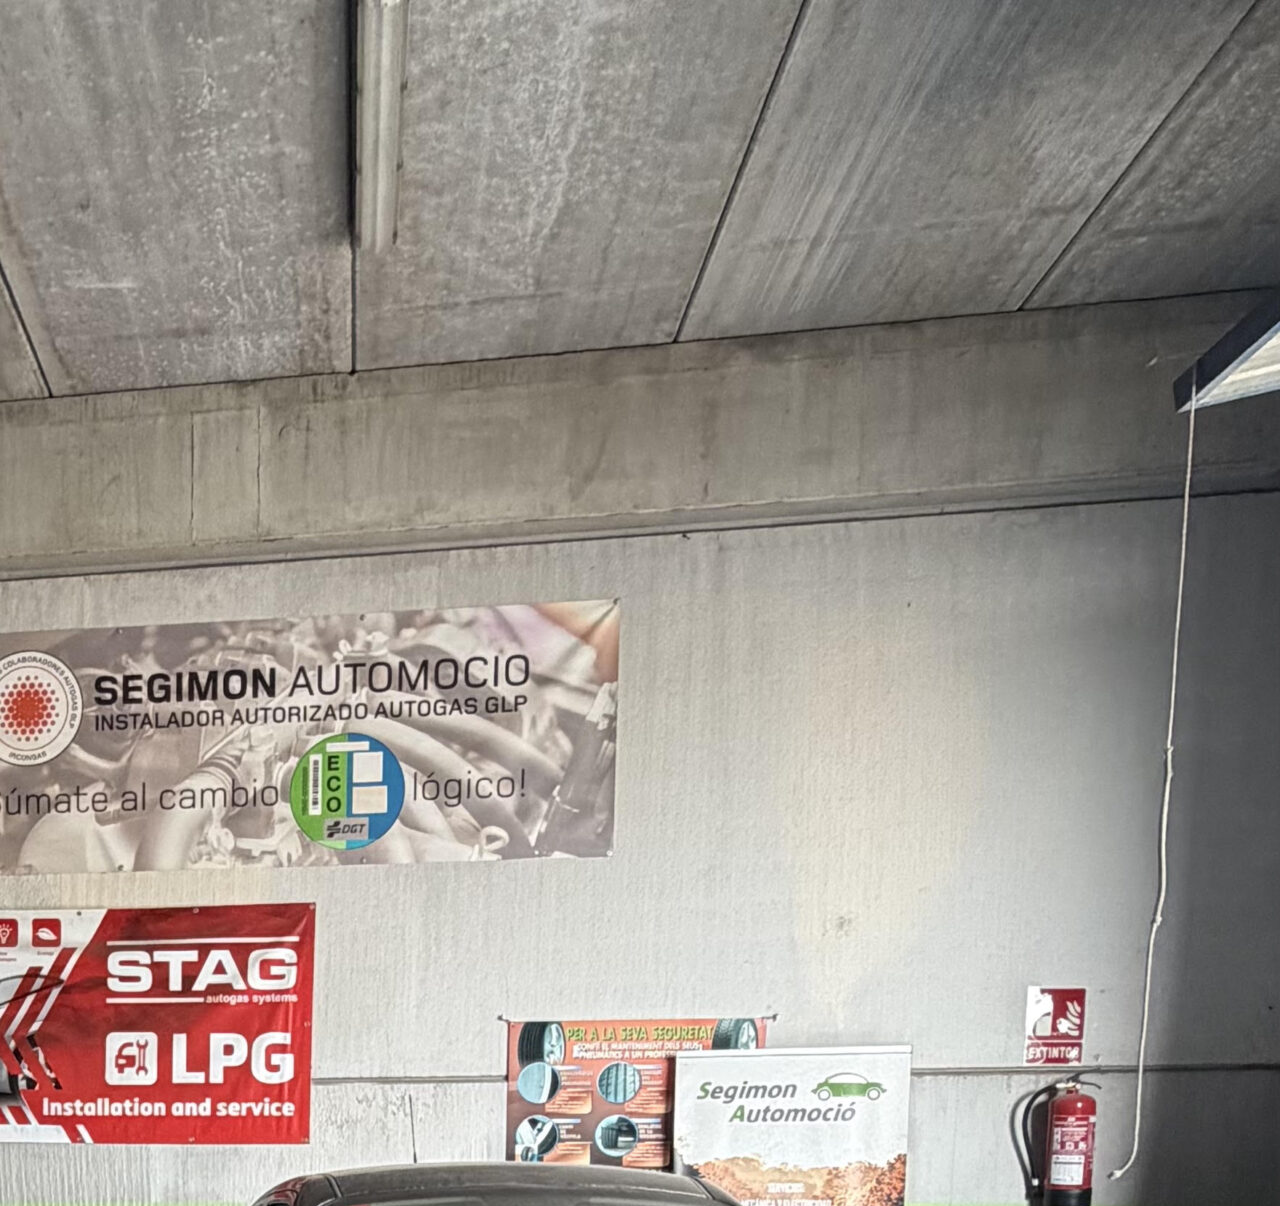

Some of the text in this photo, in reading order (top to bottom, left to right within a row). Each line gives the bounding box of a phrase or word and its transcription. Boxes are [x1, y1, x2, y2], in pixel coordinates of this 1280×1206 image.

[2, 656, 65, 677] COLABORADORES
[64, 676, 78, 711] AUTOGAS
[94, 654, 530, 706] SEGIMON AUTOMOCIO
[95, 695, 527, 731] INSTALADOR AUTORIZADO AUTOGAS GLP
[121, 781, 147, 812] al
[159, 778, 280, 811] cambio
[413, 768, 526, 807] lógico!
[326, 755, 343, 813] ECO
[341, 823, 367, 836] DGT
[106, 948, 298, 992] STAG
[205, 992, 298, 1006] autogas systems
[567, 1025, 714, 1041] PER A LA SEVA SEGURETAT
[172, 1032, 295, 1084] LPG
[42, 1097, 295, 1117] Installation and service
[696, 1081, 797, 1104] Segimon
[729, 1102, 856, 1123] Automoció
